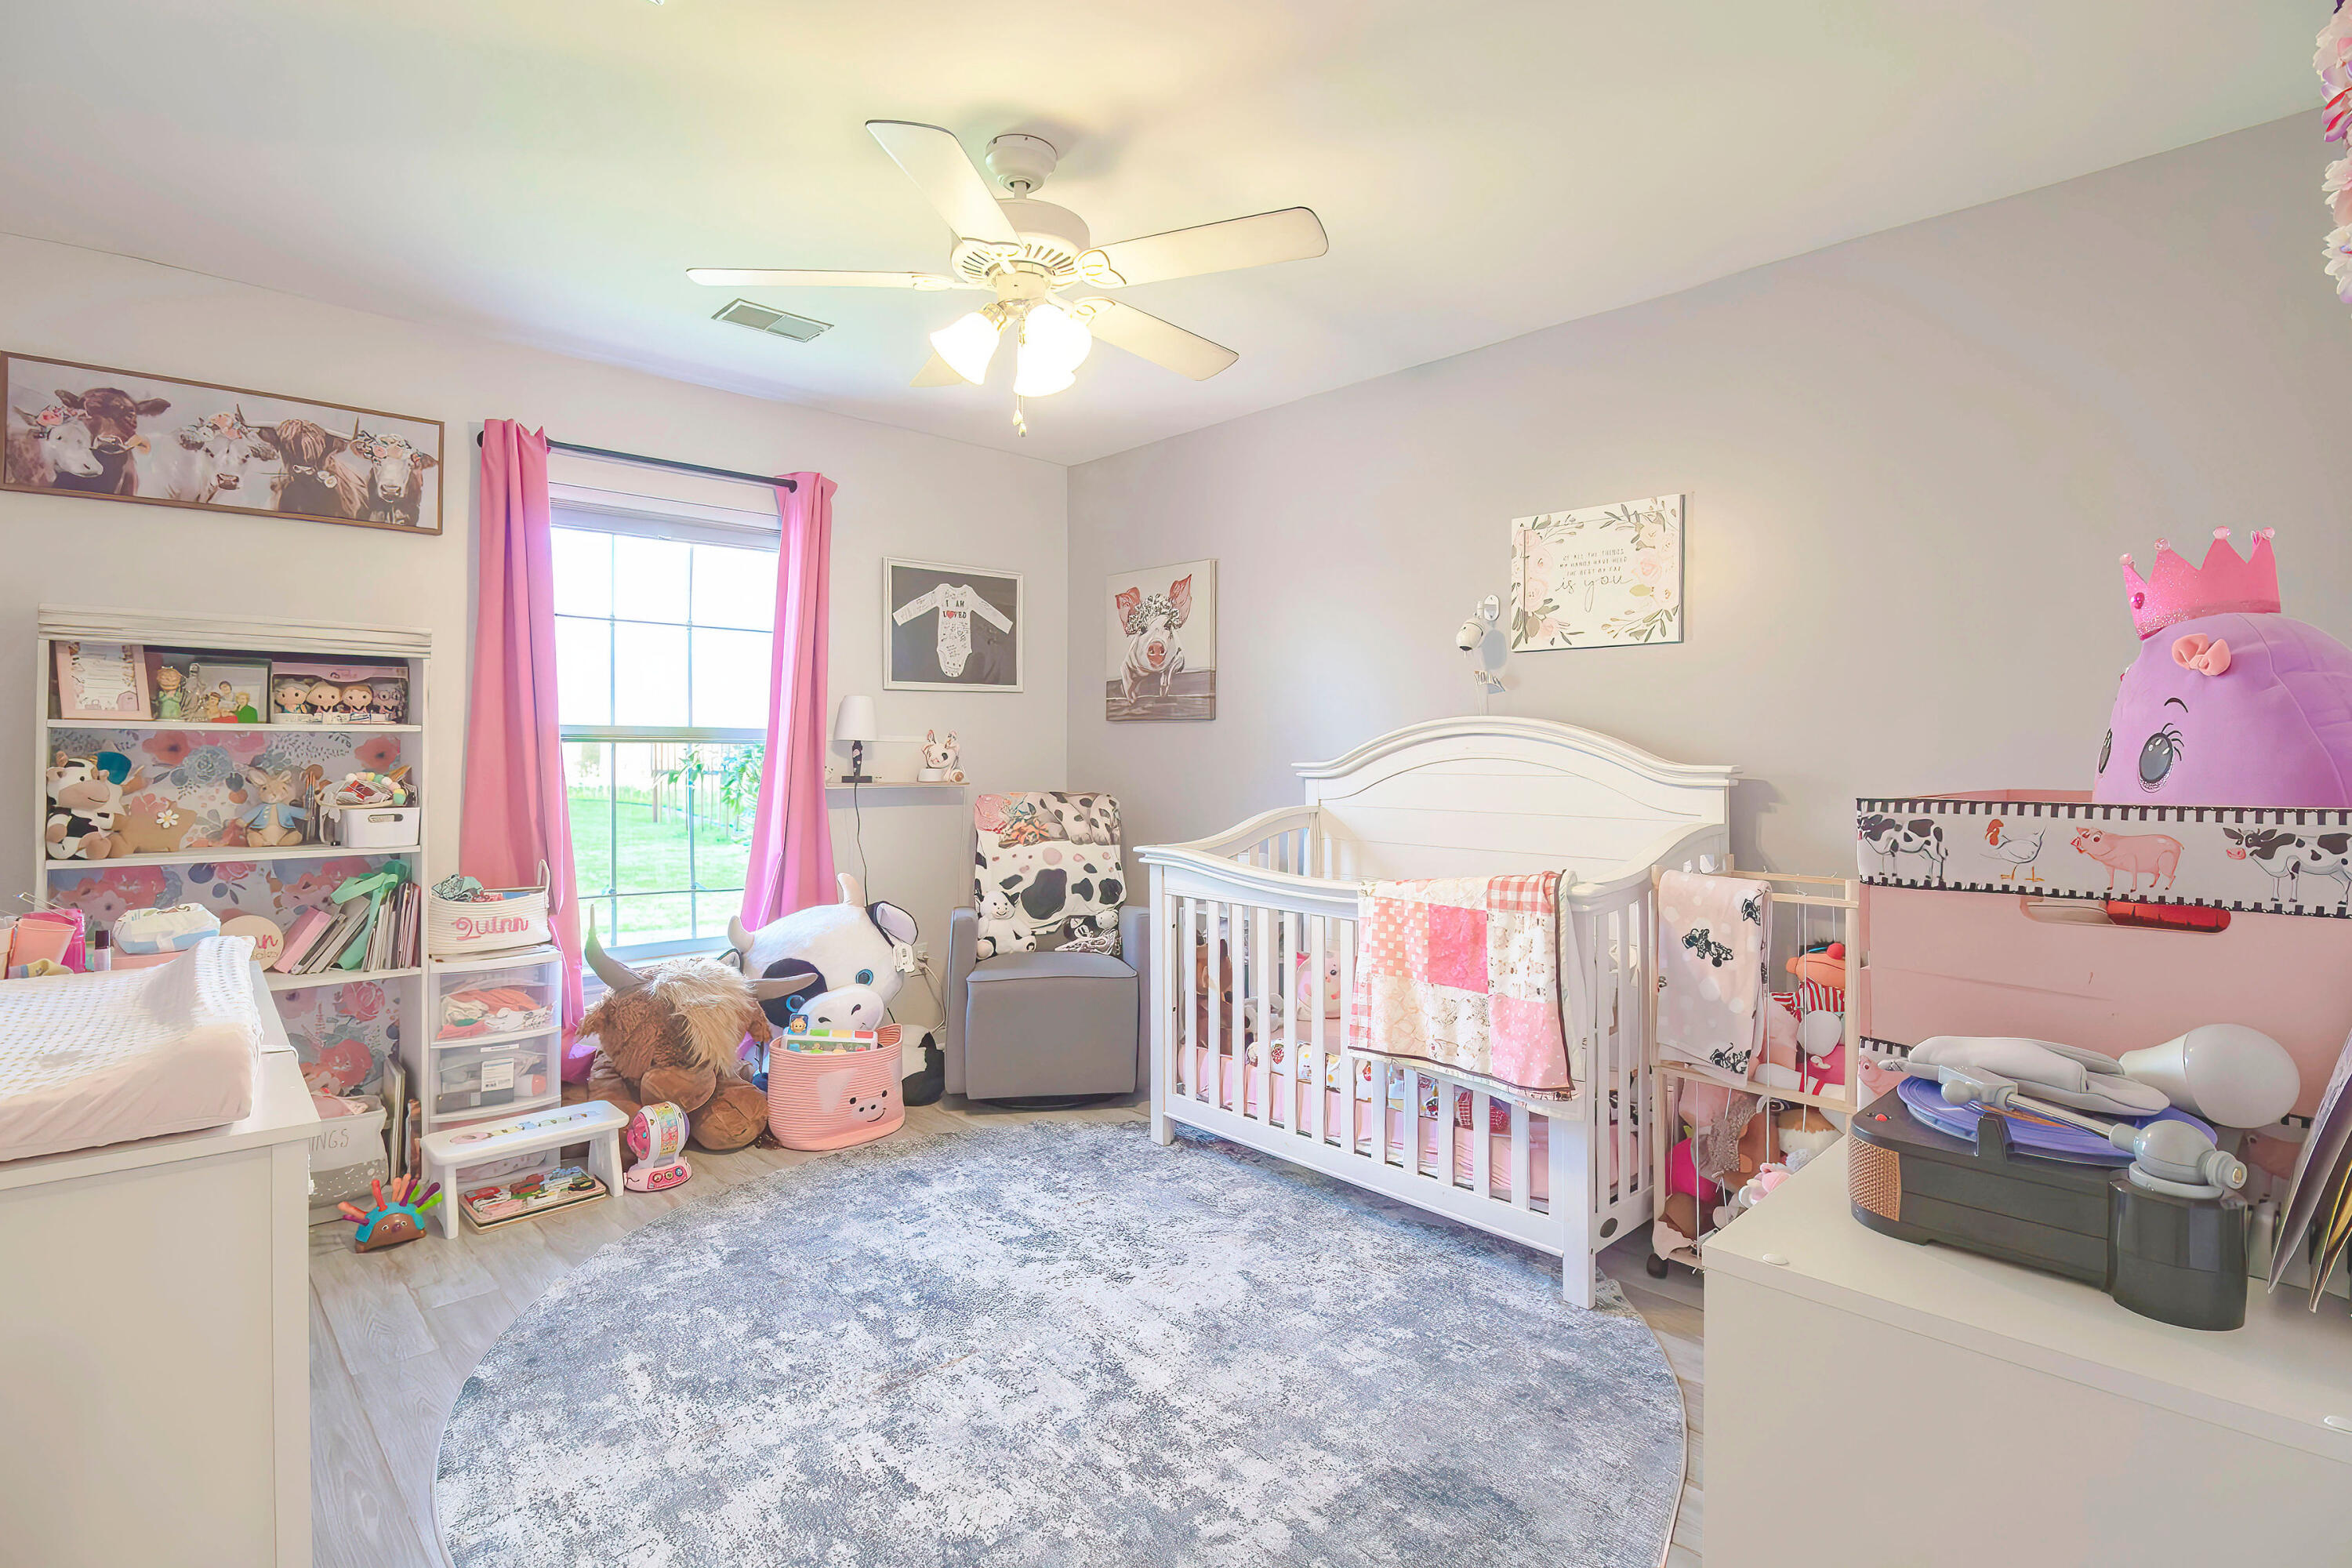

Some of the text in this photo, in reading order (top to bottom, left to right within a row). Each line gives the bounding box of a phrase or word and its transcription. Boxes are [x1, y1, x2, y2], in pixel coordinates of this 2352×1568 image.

[1555, 575, 1633, 613] is you
[943, 610, 966, 619] LVED
[451, 915, 529, 941] Quinn
